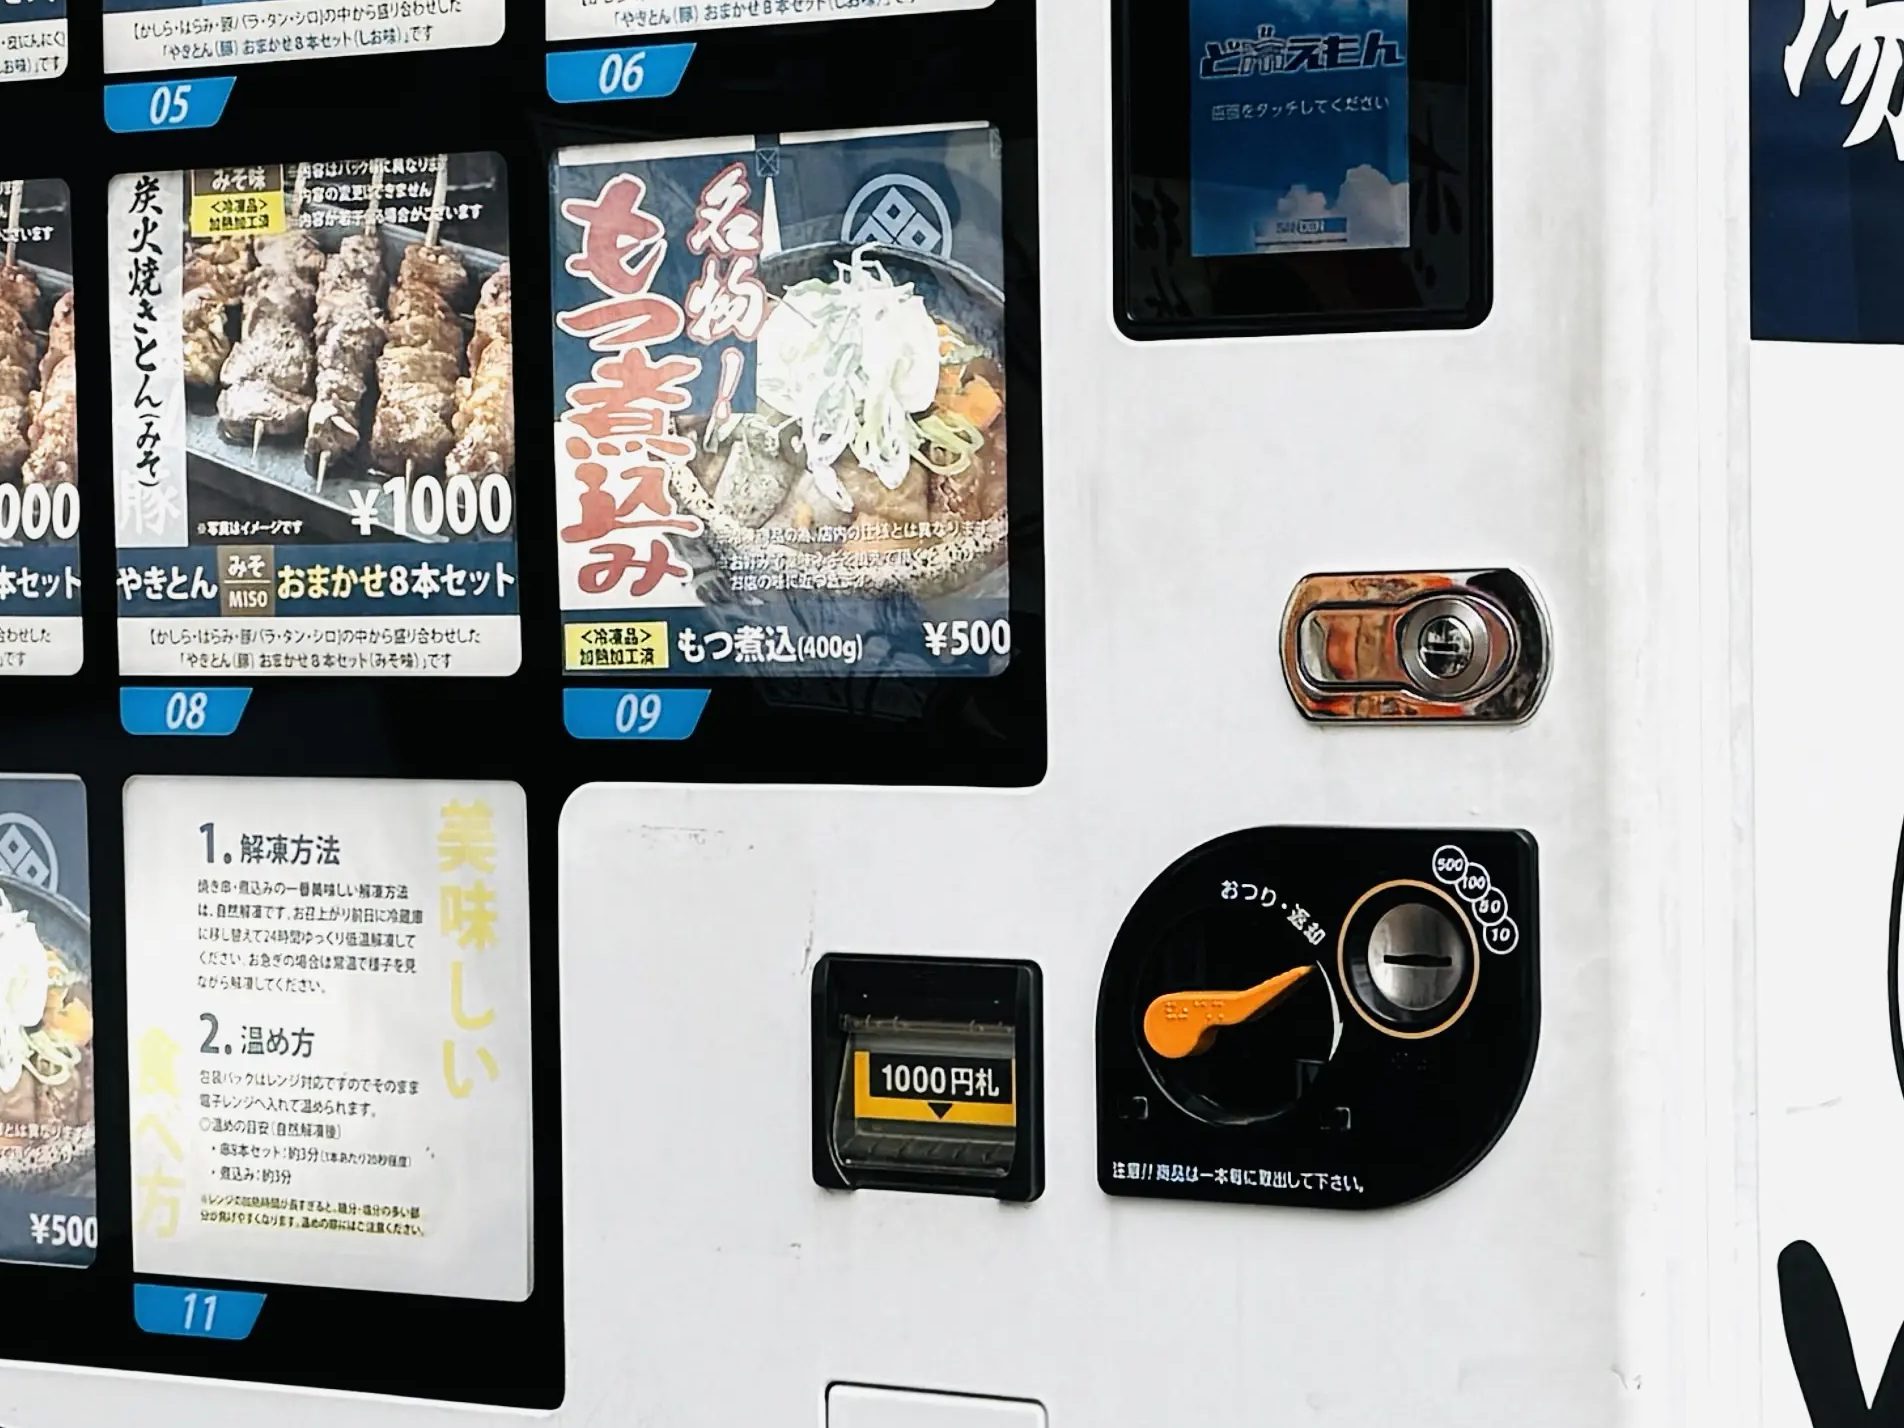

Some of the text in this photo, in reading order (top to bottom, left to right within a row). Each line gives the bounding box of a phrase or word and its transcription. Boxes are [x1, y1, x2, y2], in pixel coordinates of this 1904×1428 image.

[598, 52, 645, 94] 06
[149, 85, 192, 126] 05
[211, 168, 267, 192] みそ味
[556, 172, 704, 598] もつ煮込み
[349, 474, 513, 536] ¥1000
[116, 562, 515, 601] やきとん おまかせ8本セット
[227, 555, 266, 580] みそ
[229, 589, 268, 609] MISO
[922, 618, 1011, 657] ¥500
[166, 692, 207, 729] 08
[615, 693, 662, 734] 09
[1437, 857, 1465, 872] 500
[1461, 875, 1486, 890] 100
[437, 797, 500, 1099] 美味しい
[1491, 927, 1511, 942] 10
[881, 1065, 1000, 1097] 1000円札
[29, 1213, 98, 1248] ¥500
[183, 1292, 219, 1332] 11
